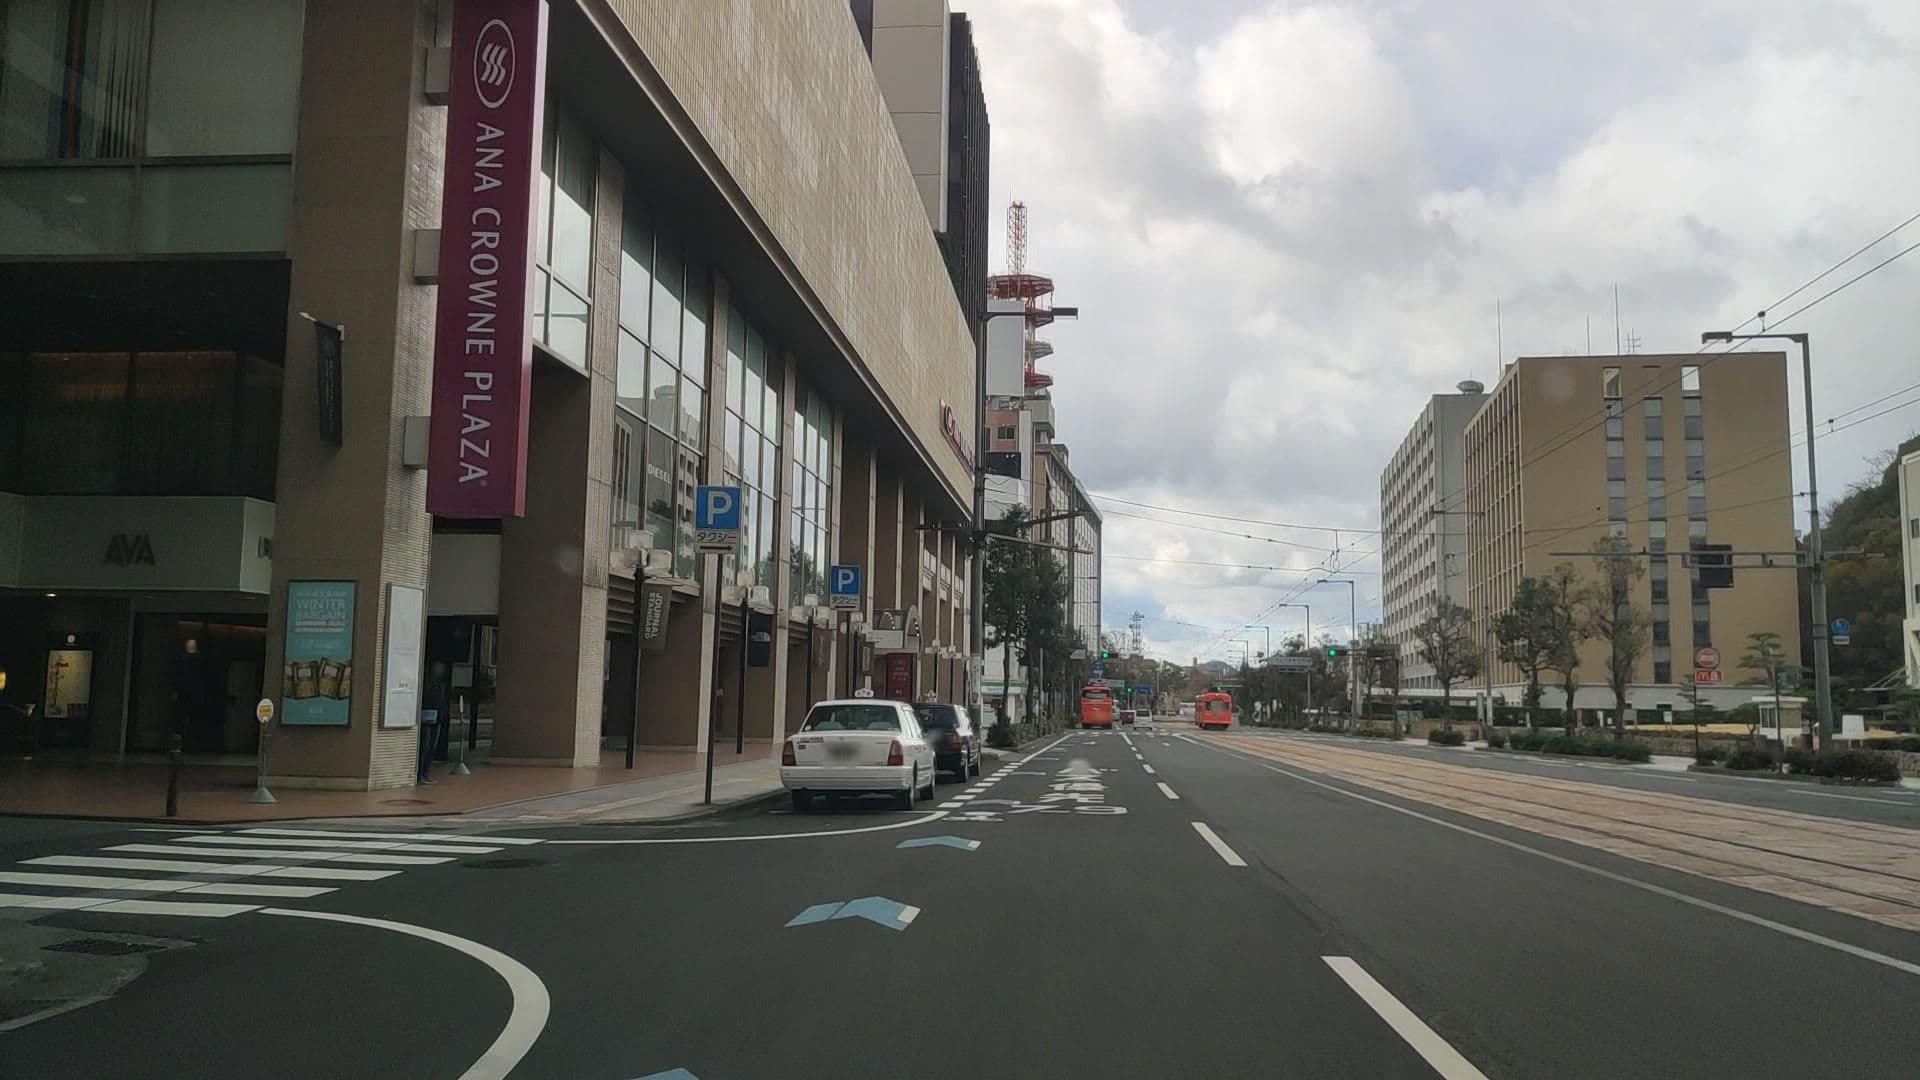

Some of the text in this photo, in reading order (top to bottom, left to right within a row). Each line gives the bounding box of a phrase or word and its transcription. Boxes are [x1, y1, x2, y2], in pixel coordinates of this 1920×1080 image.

[459, 122, 505, 483] ANA CROWNE PLAZA
[707, 490, 733, 525] P
[696, 532, 737, 542] タクシー
[838, 568, 855, 593] P
[296, 599, 345, 609] WINTER
[831, 596, 857, 605] タクシー
[644, 592, 656, 640] STANDARD
[650, 592, 663, 640] JOURNAL
